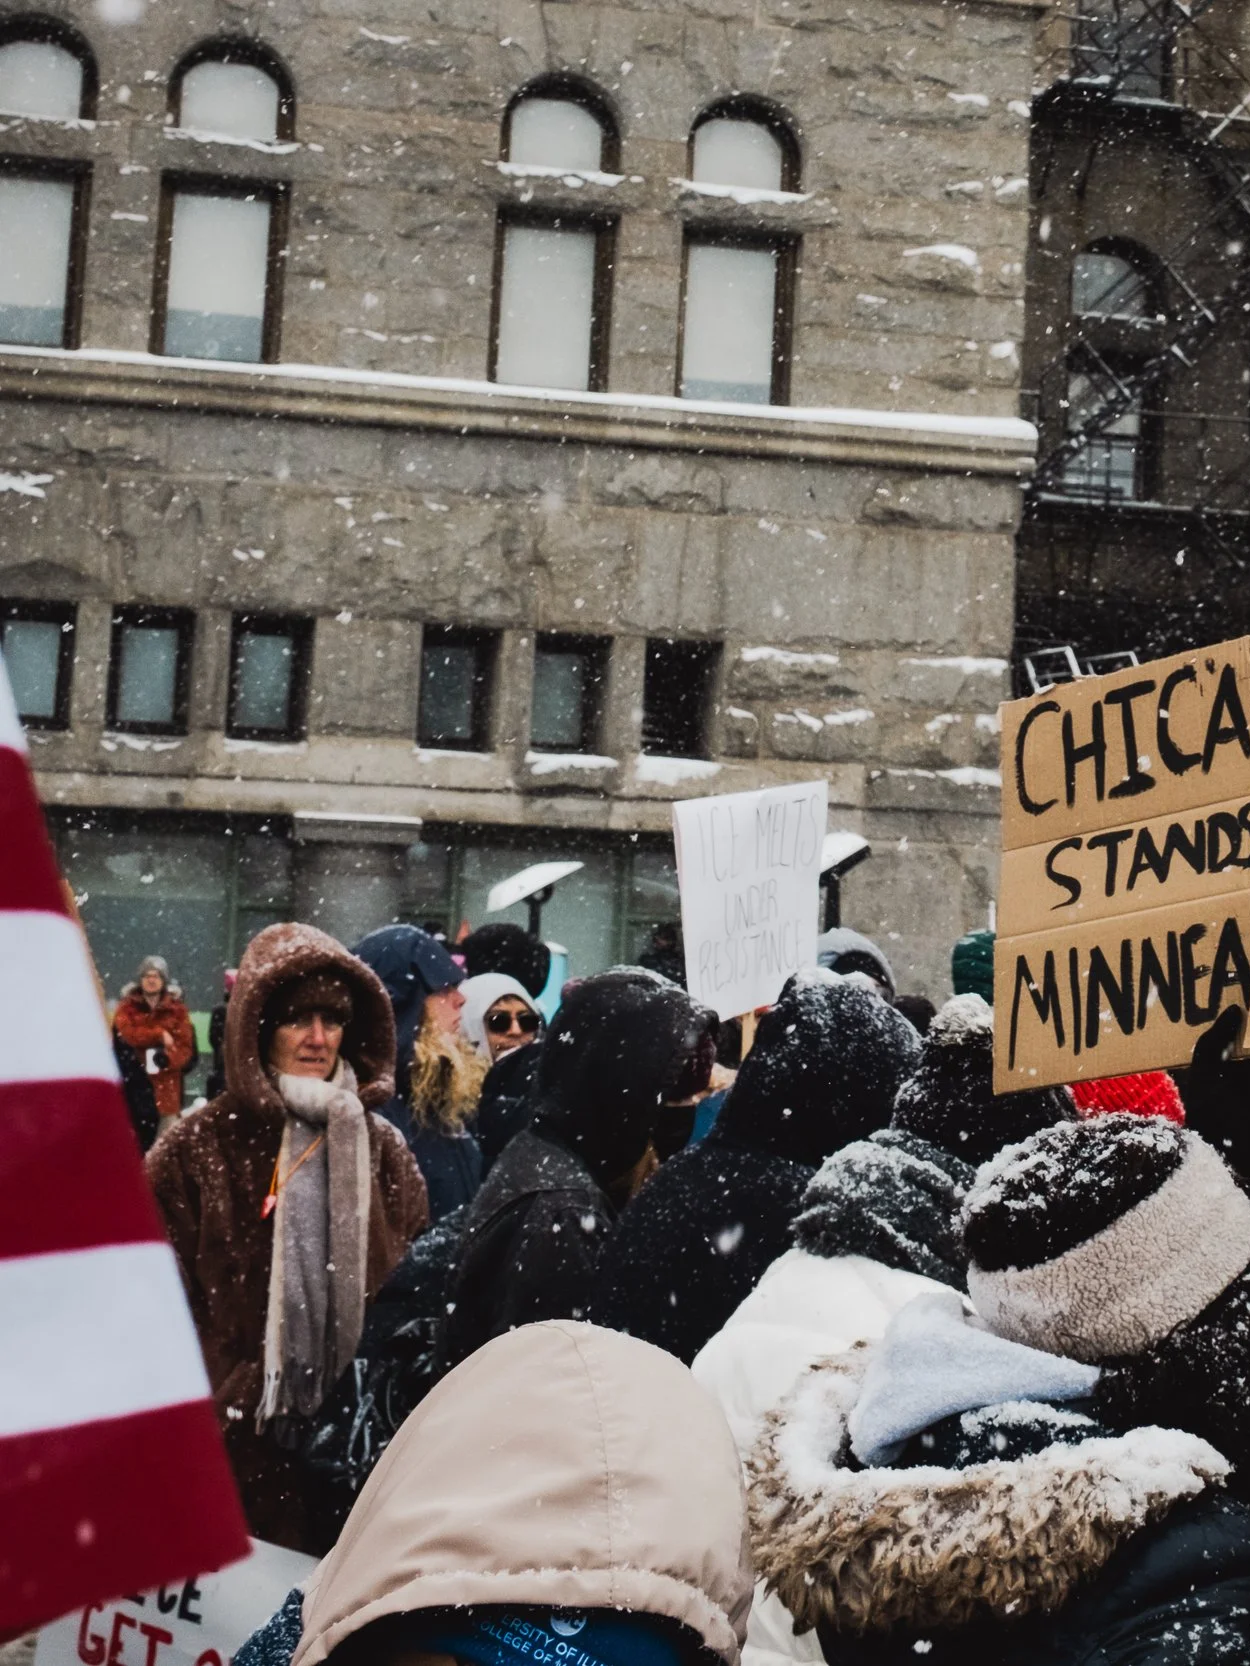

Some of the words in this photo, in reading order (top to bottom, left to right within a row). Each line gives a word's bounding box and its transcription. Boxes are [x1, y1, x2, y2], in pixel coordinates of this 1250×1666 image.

[697, 805, 740, 882] ICE
[755, 794, 818, 872] MELTS
[724, 878, 778, 937] UNDER
[699, 919, 807, 1000] RESISTANCE
[122, 1574, 202, 1625] CE
[77, 1601, 173, 1666] GET
[533, 1648, 554, 1664] OF
[555, 1641, 578, 1660] OF
